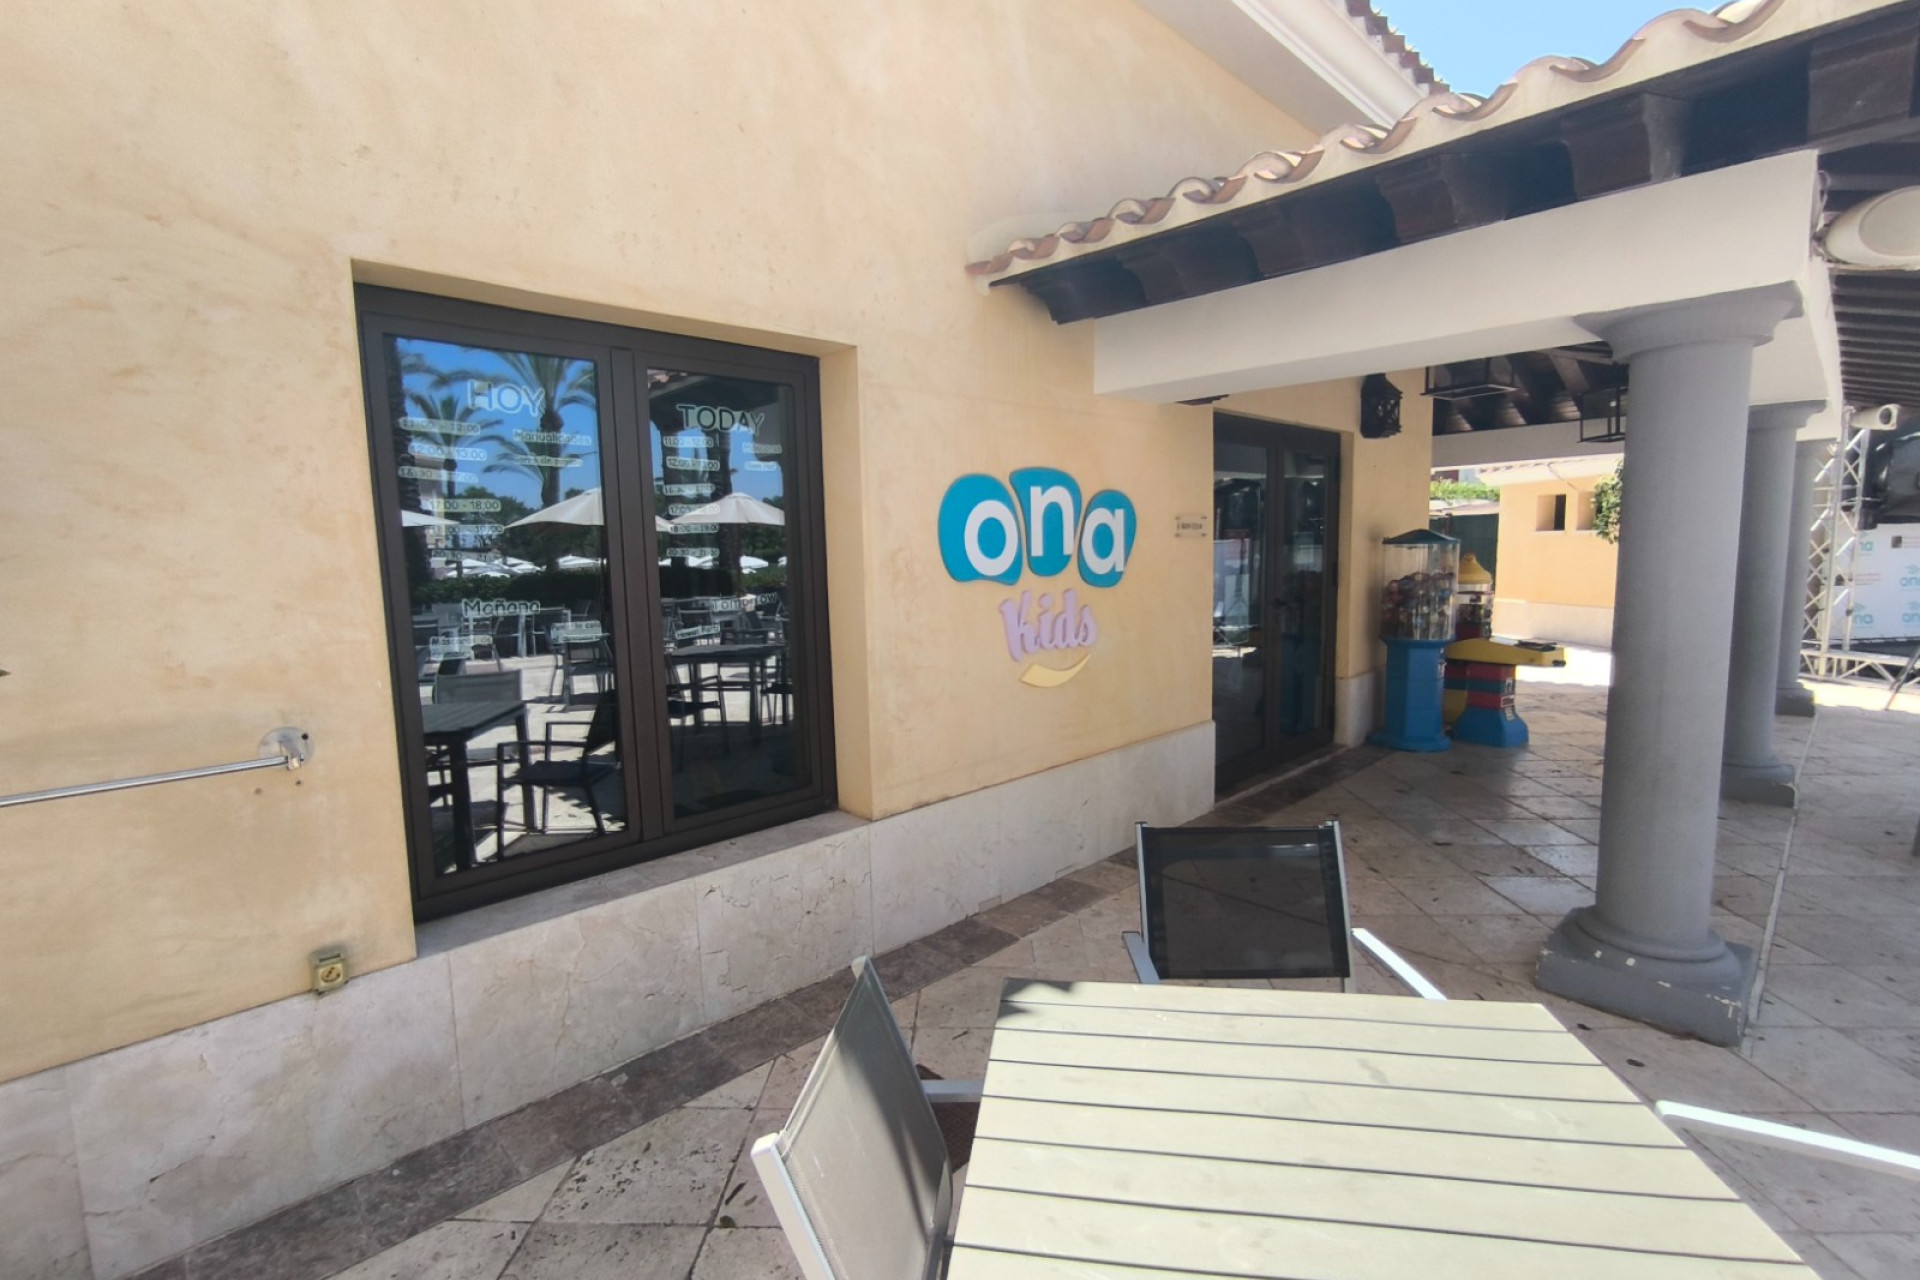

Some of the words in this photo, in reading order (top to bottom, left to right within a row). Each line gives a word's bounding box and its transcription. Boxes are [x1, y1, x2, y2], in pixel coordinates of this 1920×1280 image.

[469, 380, 545, 415] HOY
[677, 404, 764, 435] TODAY
[964, 485, 1125, 577] ona
[464, 599, 539, 616] Mañana
[713, 593, 777, 611] Tomorrow
[998, 588, 1098, 663] Kids
